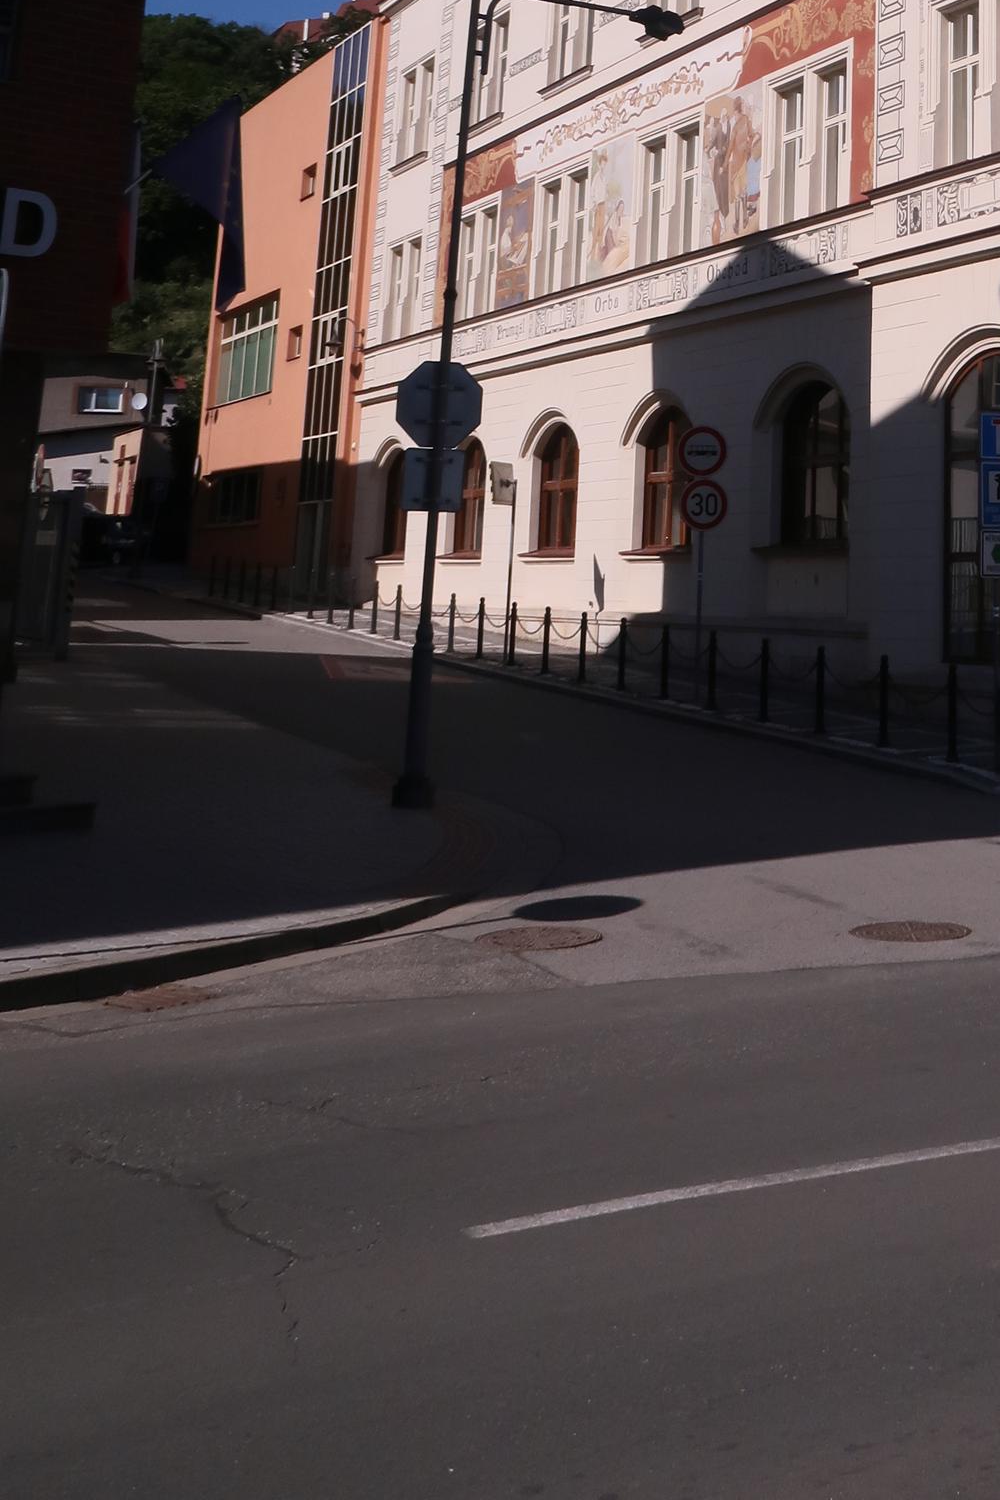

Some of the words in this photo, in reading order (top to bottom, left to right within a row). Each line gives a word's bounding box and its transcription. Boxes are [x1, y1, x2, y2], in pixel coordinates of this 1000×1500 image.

[0, 187, 58, 258] D
[595, 293, 619, 313] Orba
[691, 493, 718, 516] 30
